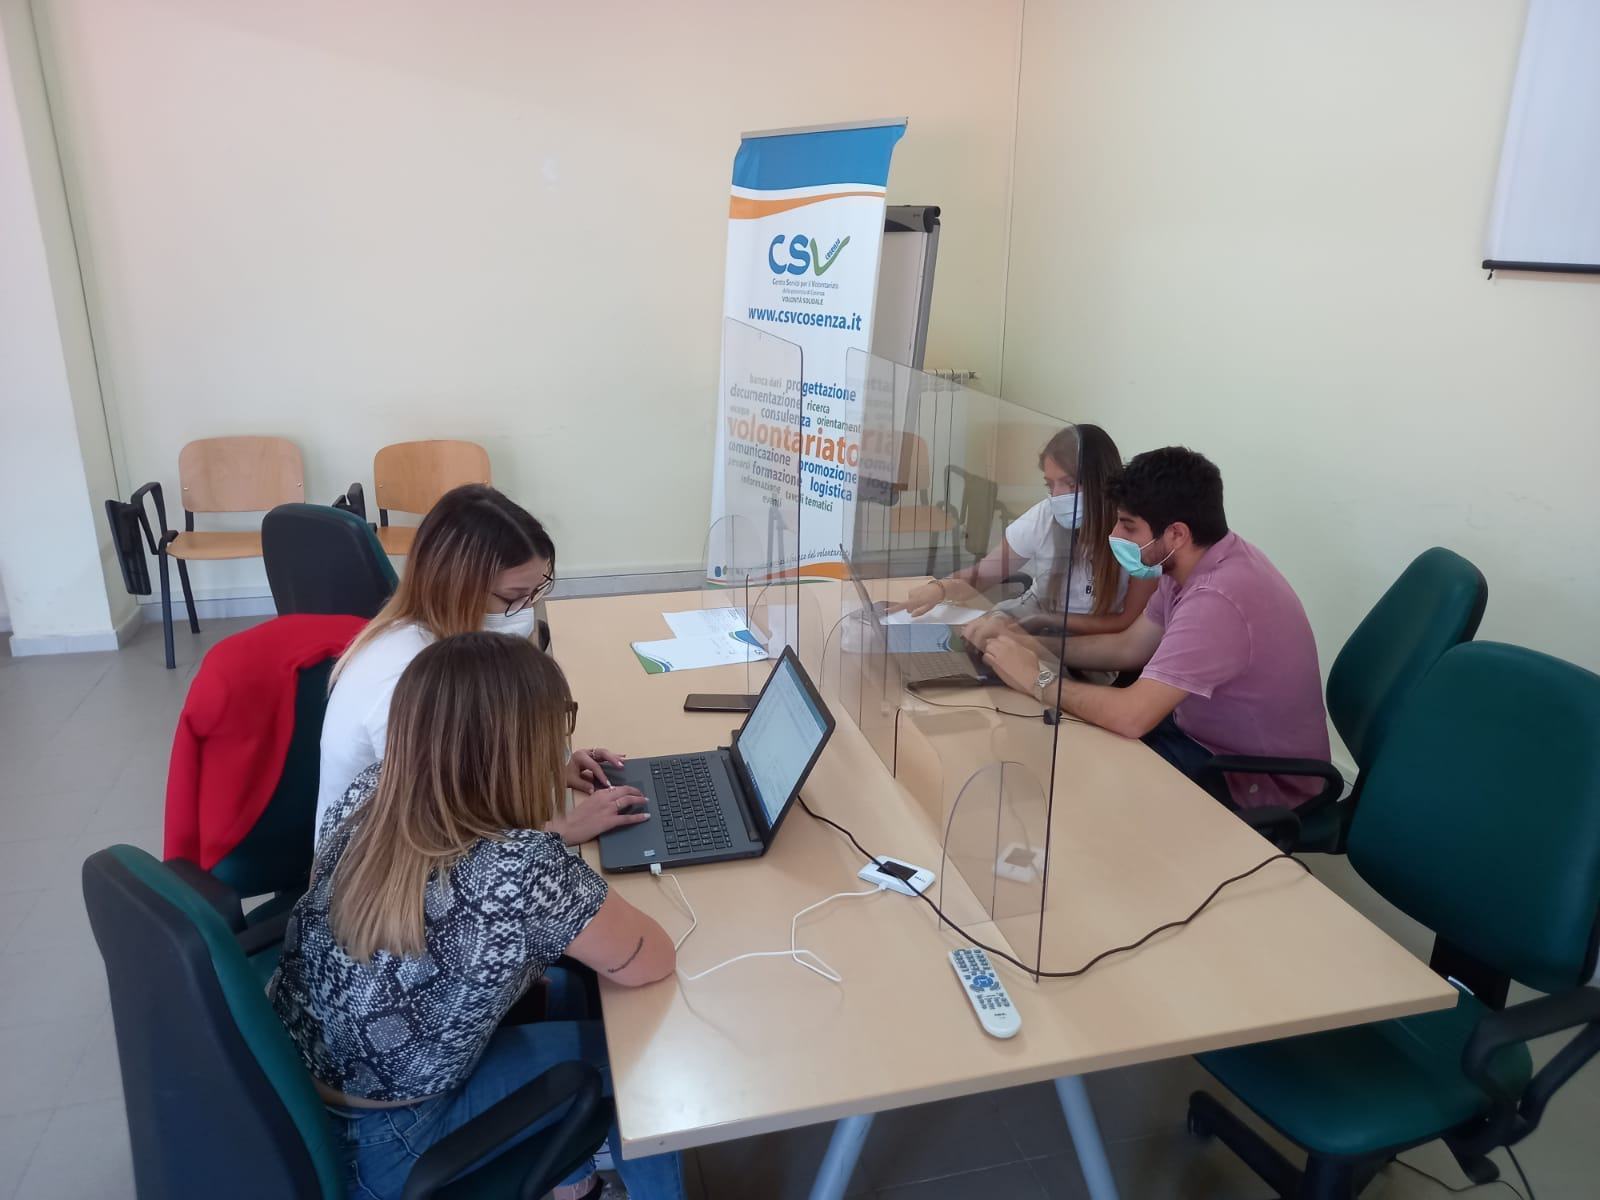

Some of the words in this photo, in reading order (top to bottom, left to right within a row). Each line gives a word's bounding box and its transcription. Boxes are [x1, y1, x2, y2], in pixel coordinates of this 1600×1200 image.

[768, 234, 851, 276] CSV
[749, 307, 862, 331] www.csvcosenza.it
[730, 383, 801, 410] documentazione
[807, 400, 830, 414] ricerca
[786, 379, 857, 402] progettazione
[761, 408, 811, 428] consulenza
[726, 414, 860, 467] volontariato
[728, 440, 791, 466] comunicazione
[799, 460, 857, 484] promozione
[752, 461, 802, 487] formazione
[810, 477, 852, 502] logistica
[805, 496, 833, 512] tematici
